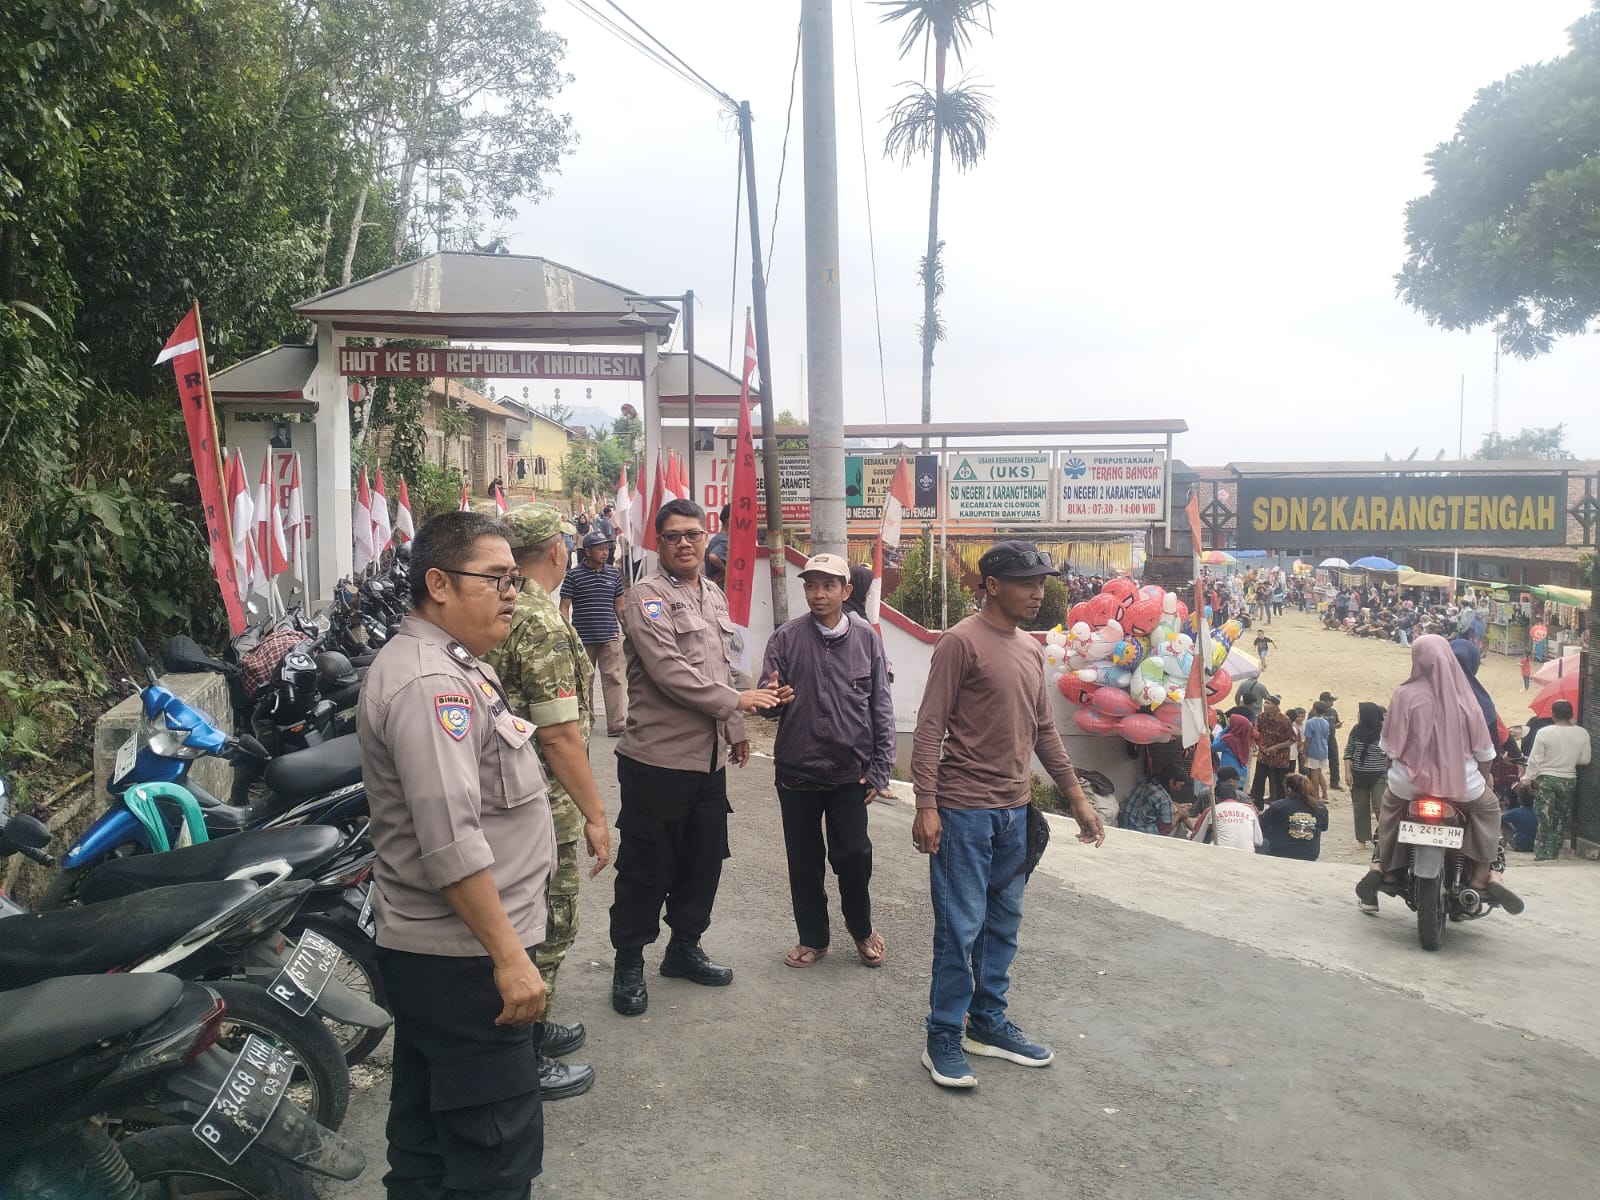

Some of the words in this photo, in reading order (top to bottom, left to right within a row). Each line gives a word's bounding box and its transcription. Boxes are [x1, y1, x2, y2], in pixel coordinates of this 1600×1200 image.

[342, 351, 378, 372] HUT
[386, 351, 411, 372] KE
[416, 352, 435, 372] 81
[447, 353, 539, 374] REPUBLIK
[544, 354, 641, 376] INDONESIA
[278, 454, 293, 479] 7
[781, 478, 810, 489] ARANGTE
[950, 486, 959, 500] SD
[962, 486, 985, 500] NEGERI
[987, 486, 991, 499] 2
[993, 485, 1047, 499] KARANGTENGAH
[1063, 485, 1072, 500] SD
[1074, 485, 1098, 500] NEGERI
[1100, 486, 1104, 499] 2
[1106, 485, 1161, 499] KARANGTENGAH
[853, 507, 877, 518] NEGERI
[901, 506, 936, 518] NGTENGAH
[1067, 503, 1087, 515] BUKA
[1092, 503, 1113, 514] 07:30
[1120, 503, 1140, 514] 14:00
[1142, 503, 1156, 514] WIB
[1401, 823, 1414, 833] AA
[274, 985, 295, 1001] R
[201, 1124, 220, 1143] B
[246, 1039, 272, 1070] KHH
